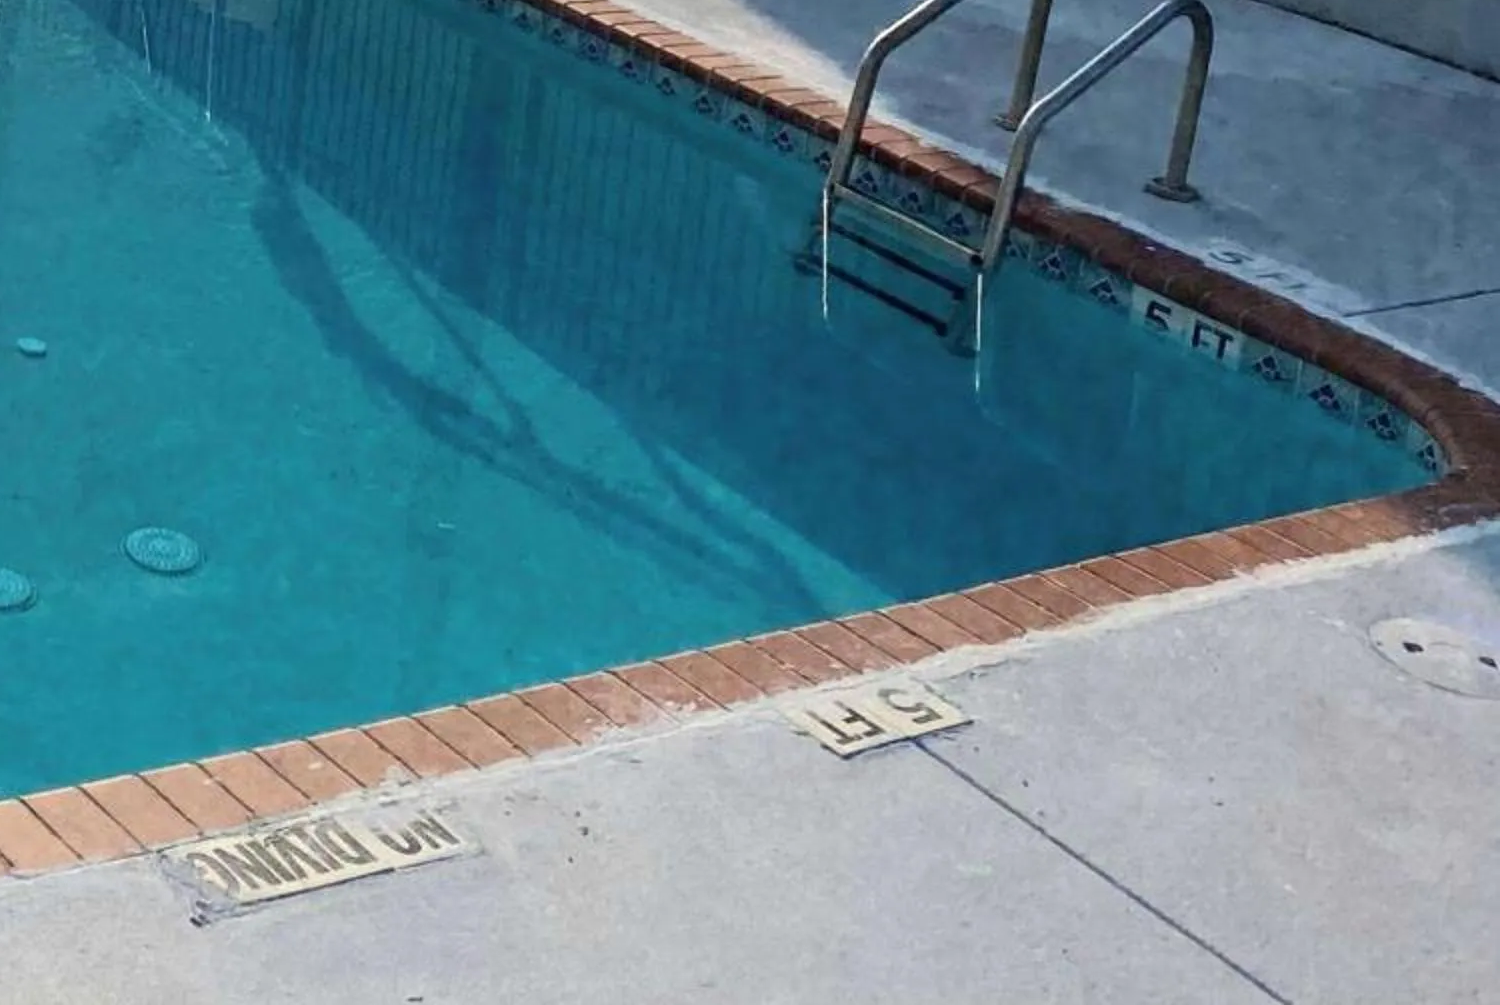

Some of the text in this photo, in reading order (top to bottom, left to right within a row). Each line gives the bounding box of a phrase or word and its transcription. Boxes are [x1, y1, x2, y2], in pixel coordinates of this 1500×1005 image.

[1145, 299, 1234, 359] 5 FT
[806, 688, 943, 745] 5 FT
